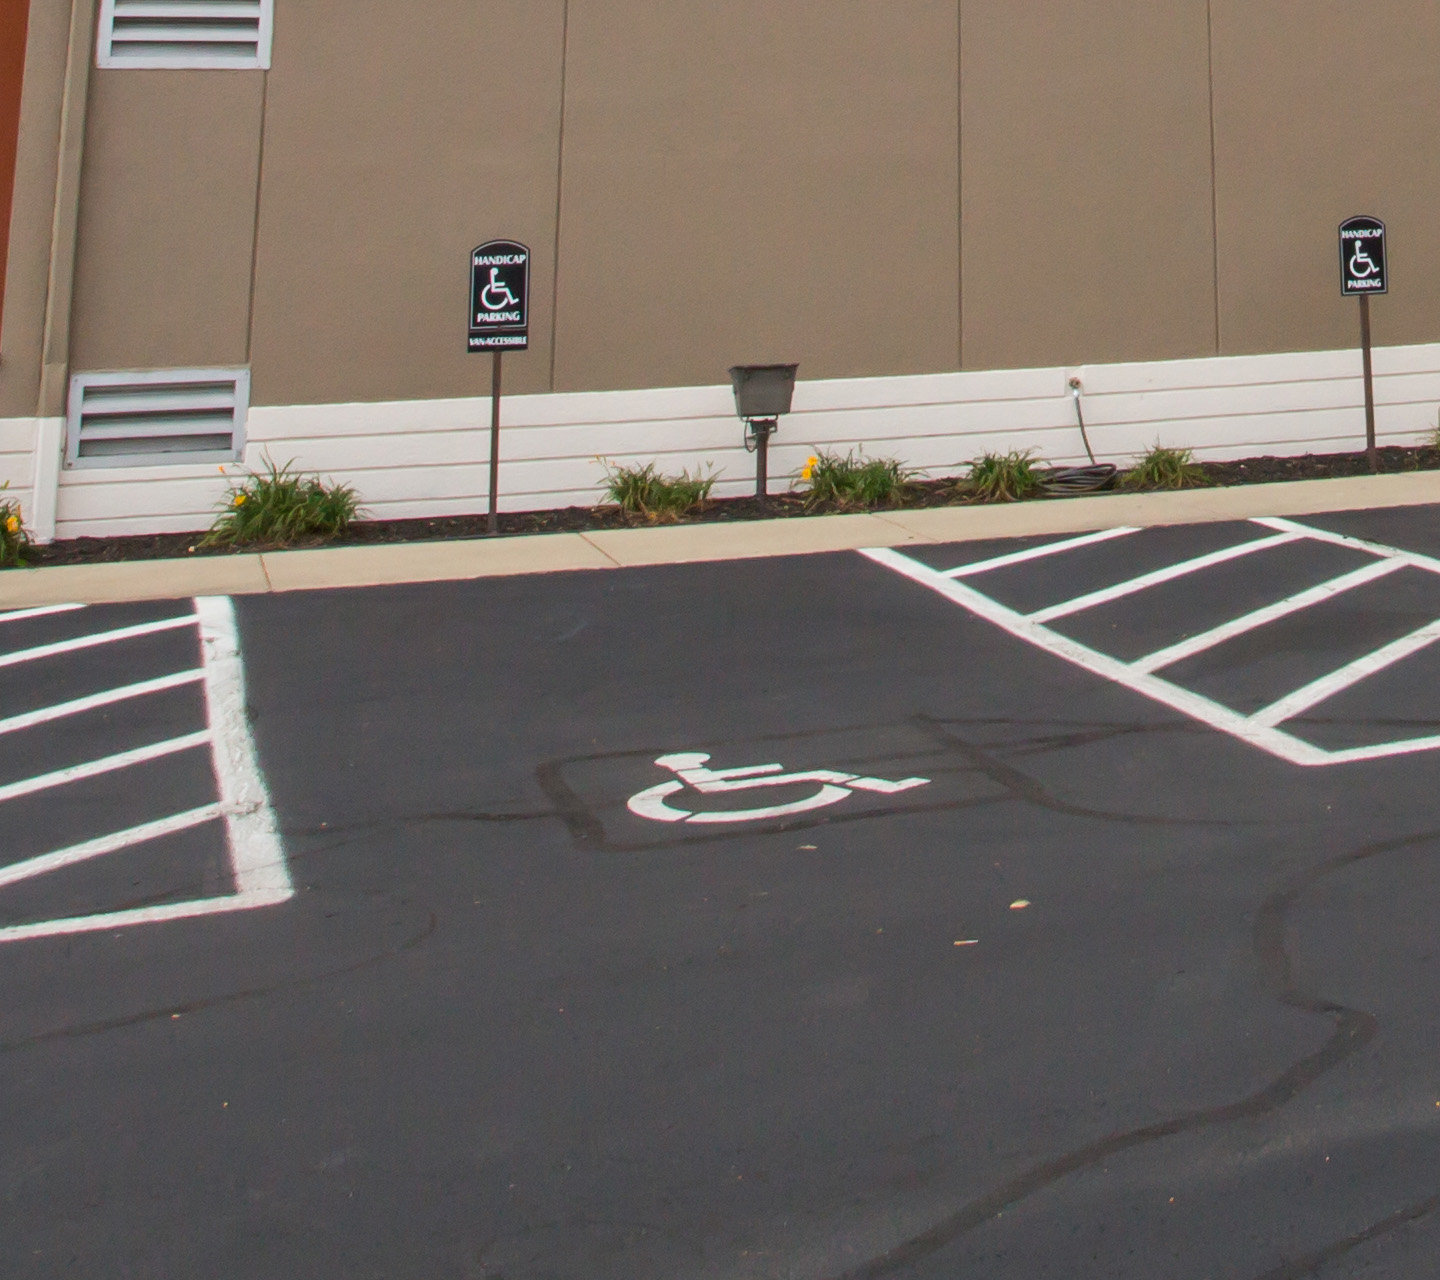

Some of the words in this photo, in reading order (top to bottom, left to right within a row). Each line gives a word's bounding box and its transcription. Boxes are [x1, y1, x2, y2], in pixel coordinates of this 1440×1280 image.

[1341, 228, 1383, 239] HANDICAP
[474, 254, 527, 266] HANDICAP
[1347, 278, 1381, 289] PARKING
[477, 311, 520, 323] PARKING
